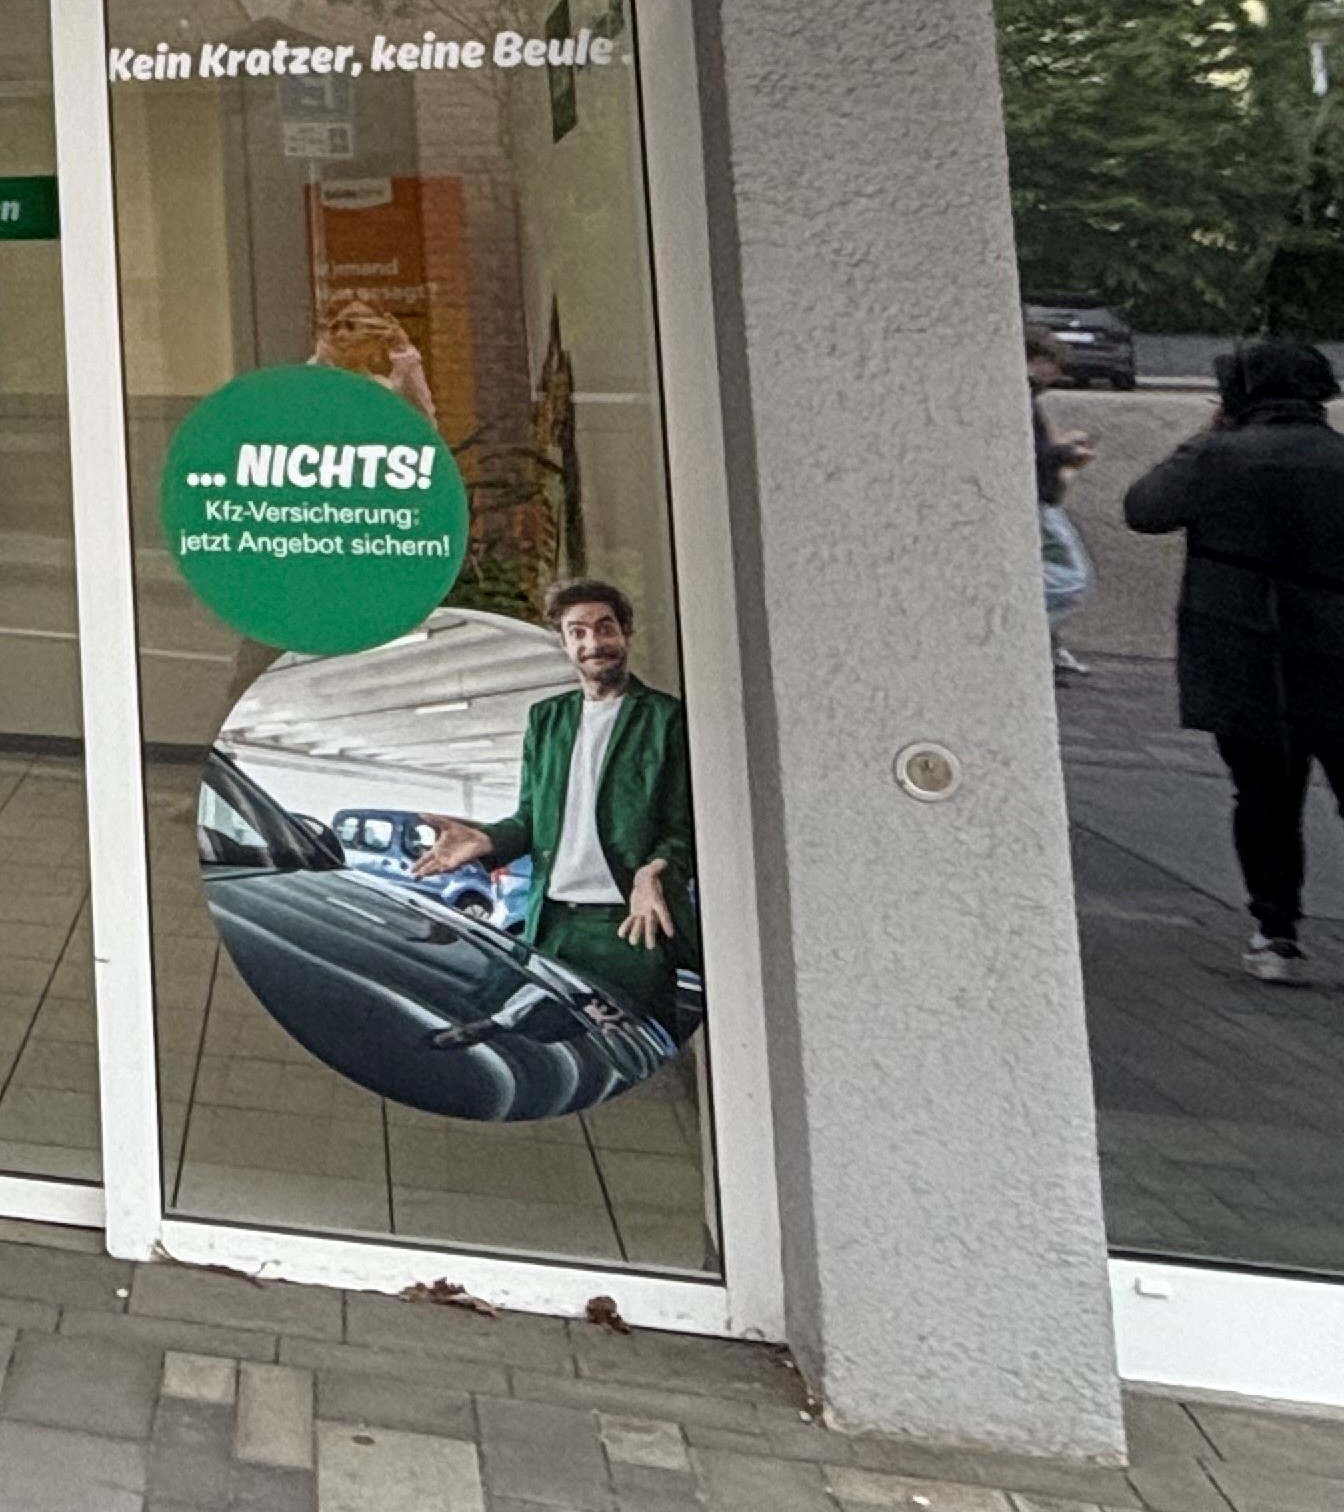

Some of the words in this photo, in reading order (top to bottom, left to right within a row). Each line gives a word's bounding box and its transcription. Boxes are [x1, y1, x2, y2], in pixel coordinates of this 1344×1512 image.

[109, 42, 192, 82] Kein
[199, 40, 362, 78] Kratzer,
[371, 30, 486, 72] keine
[493, 28, 614, 68] Beule
[236, 443, 437, 490] NICHTS!
[205, 500, 421, 530] Kfz-Versicherung:
[180, 528, 232, 556] jetzt
[237, 530, 345, 558] Angebot
[350, 533, 451, 558] sichern!
